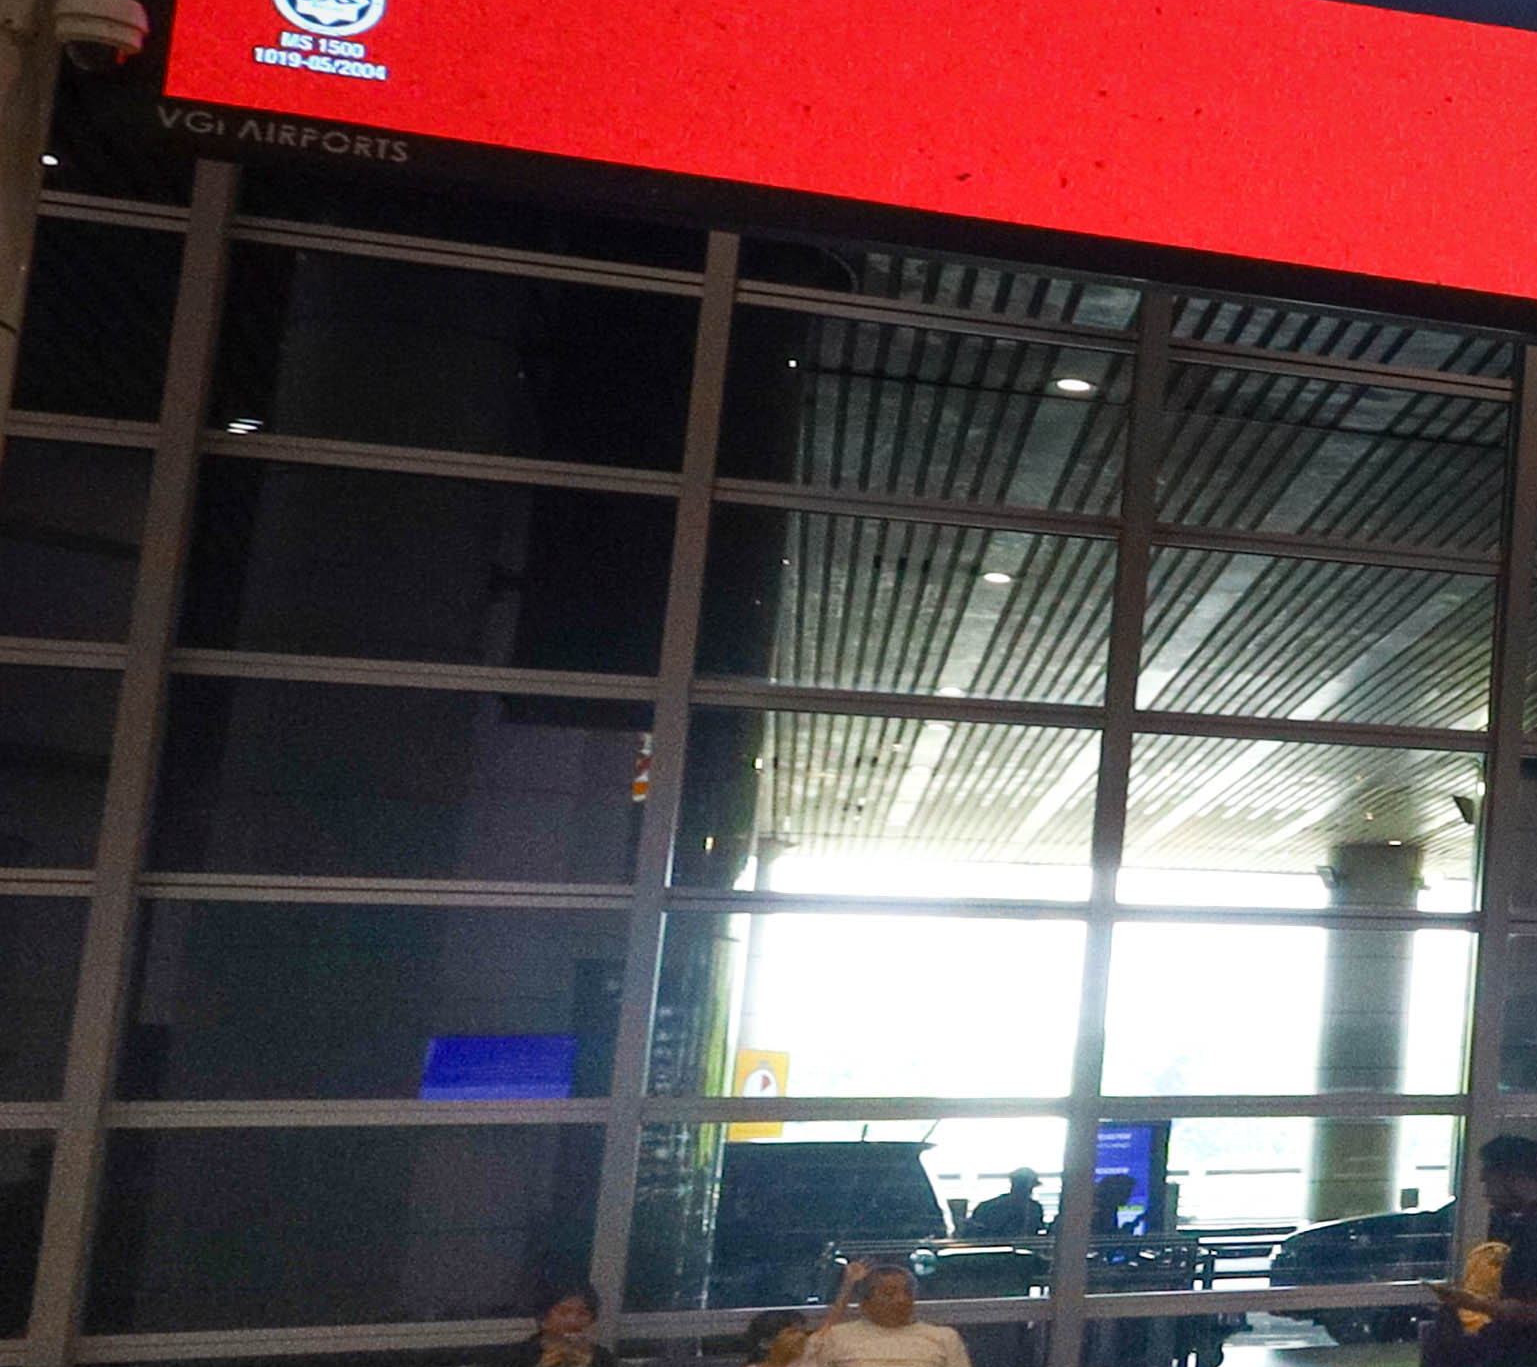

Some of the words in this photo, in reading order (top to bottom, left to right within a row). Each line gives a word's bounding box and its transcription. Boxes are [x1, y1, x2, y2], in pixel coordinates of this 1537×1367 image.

[280, 32, 314, 51] MS
[318, 37, 366, 59] 1500
[237, 119, 409, 163] AIRPORTS
